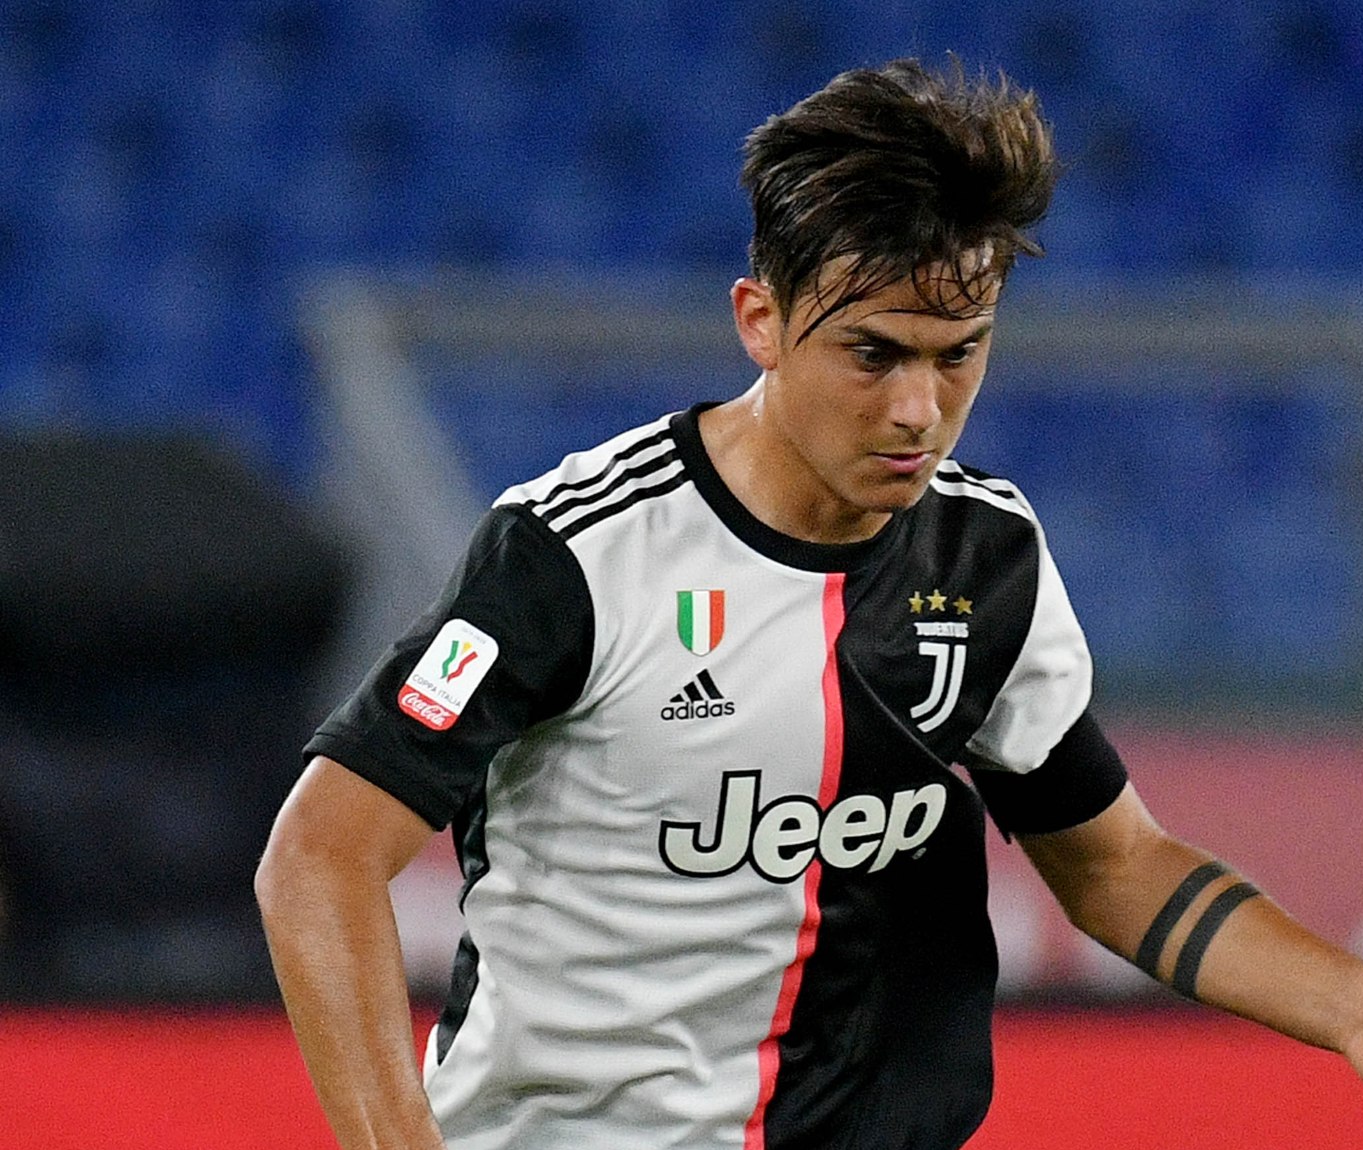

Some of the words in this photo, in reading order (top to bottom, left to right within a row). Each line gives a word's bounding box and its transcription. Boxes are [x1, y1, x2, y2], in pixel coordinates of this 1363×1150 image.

[411, 673, 438, 692] COPPA
[660, 700, 735, 721] adidas
[659, 769, 948, 884] Jeep
